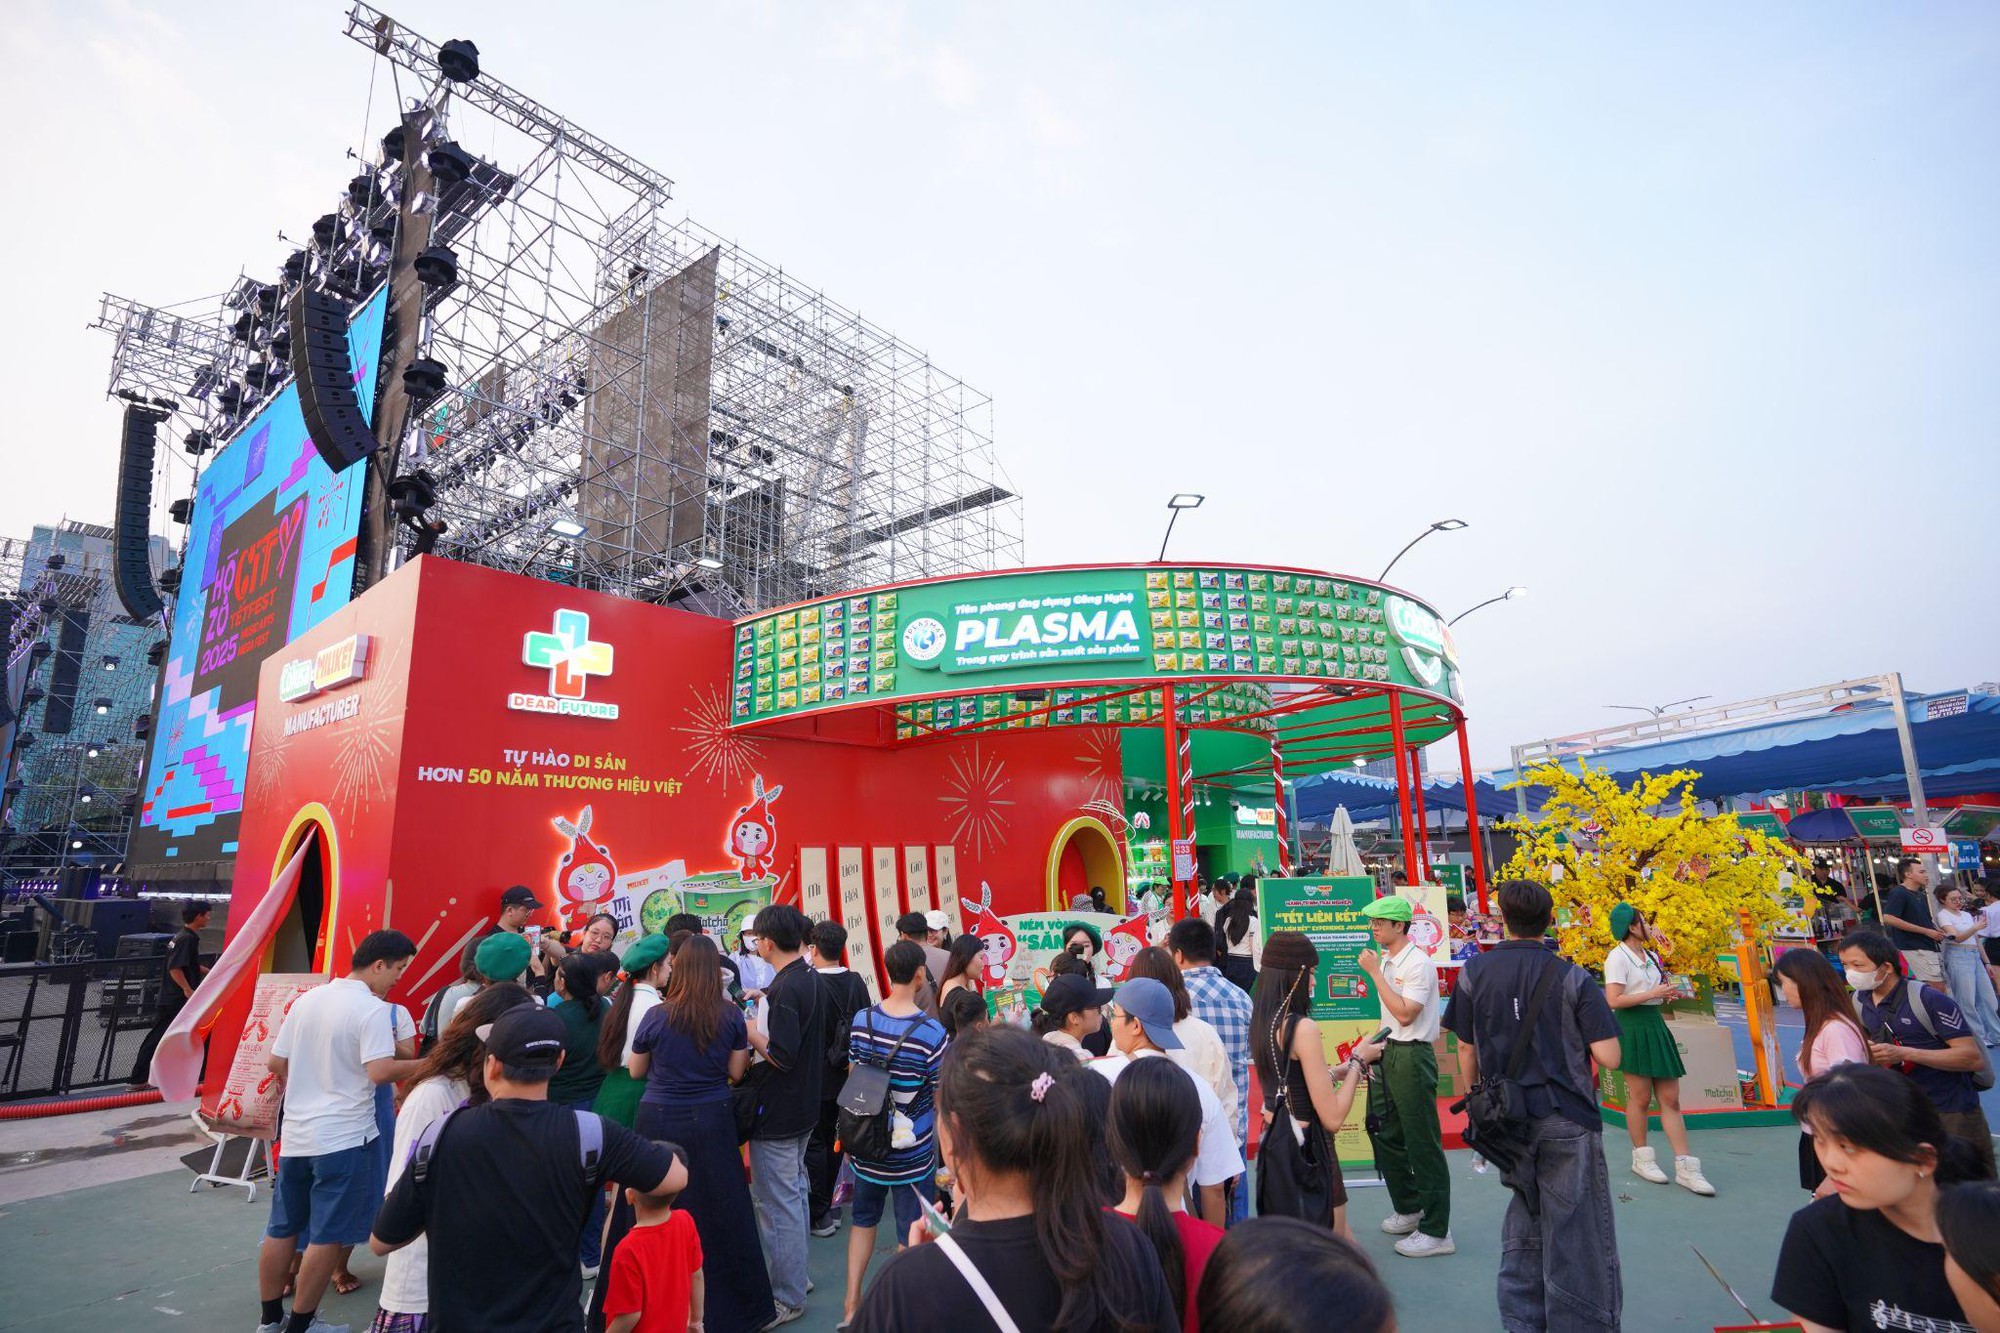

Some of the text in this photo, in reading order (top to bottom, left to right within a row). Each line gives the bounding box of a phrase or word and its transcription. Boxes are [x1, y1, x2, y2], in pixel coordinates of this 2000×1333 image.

[979, 601, 1016, 614] phong
[1042, 596, 1071, 607] dụng
[1073, 594, 1102, 606] Công
[1104, 592, 1134, 604] Nghệ
[955, 609, 1140, 651] PLASMA
[200, 634, 239, 676] 2025
[955, 656, 987, 666] Trong
[988, 653, 1010, 665] quy
[1011, 649, 1038, 661] trình
[283, 694, 361, 737] MANUFACTURER
[513, 696, 617, 717] DEAR FUTURE
[503, 748, 626, 771] TỰ HÀO DI SẢN
[418, 766, 683, 797] HƠN 50 NĂM THƯƠNG HIỆU VIỆT
[697, 915, 729, 928] atcha
[1019, 918, 1045, 930] NÉM
[1306, 910, 1333, 923] LIÊN
[1704, 1086, 1733, 1098] Matcha
